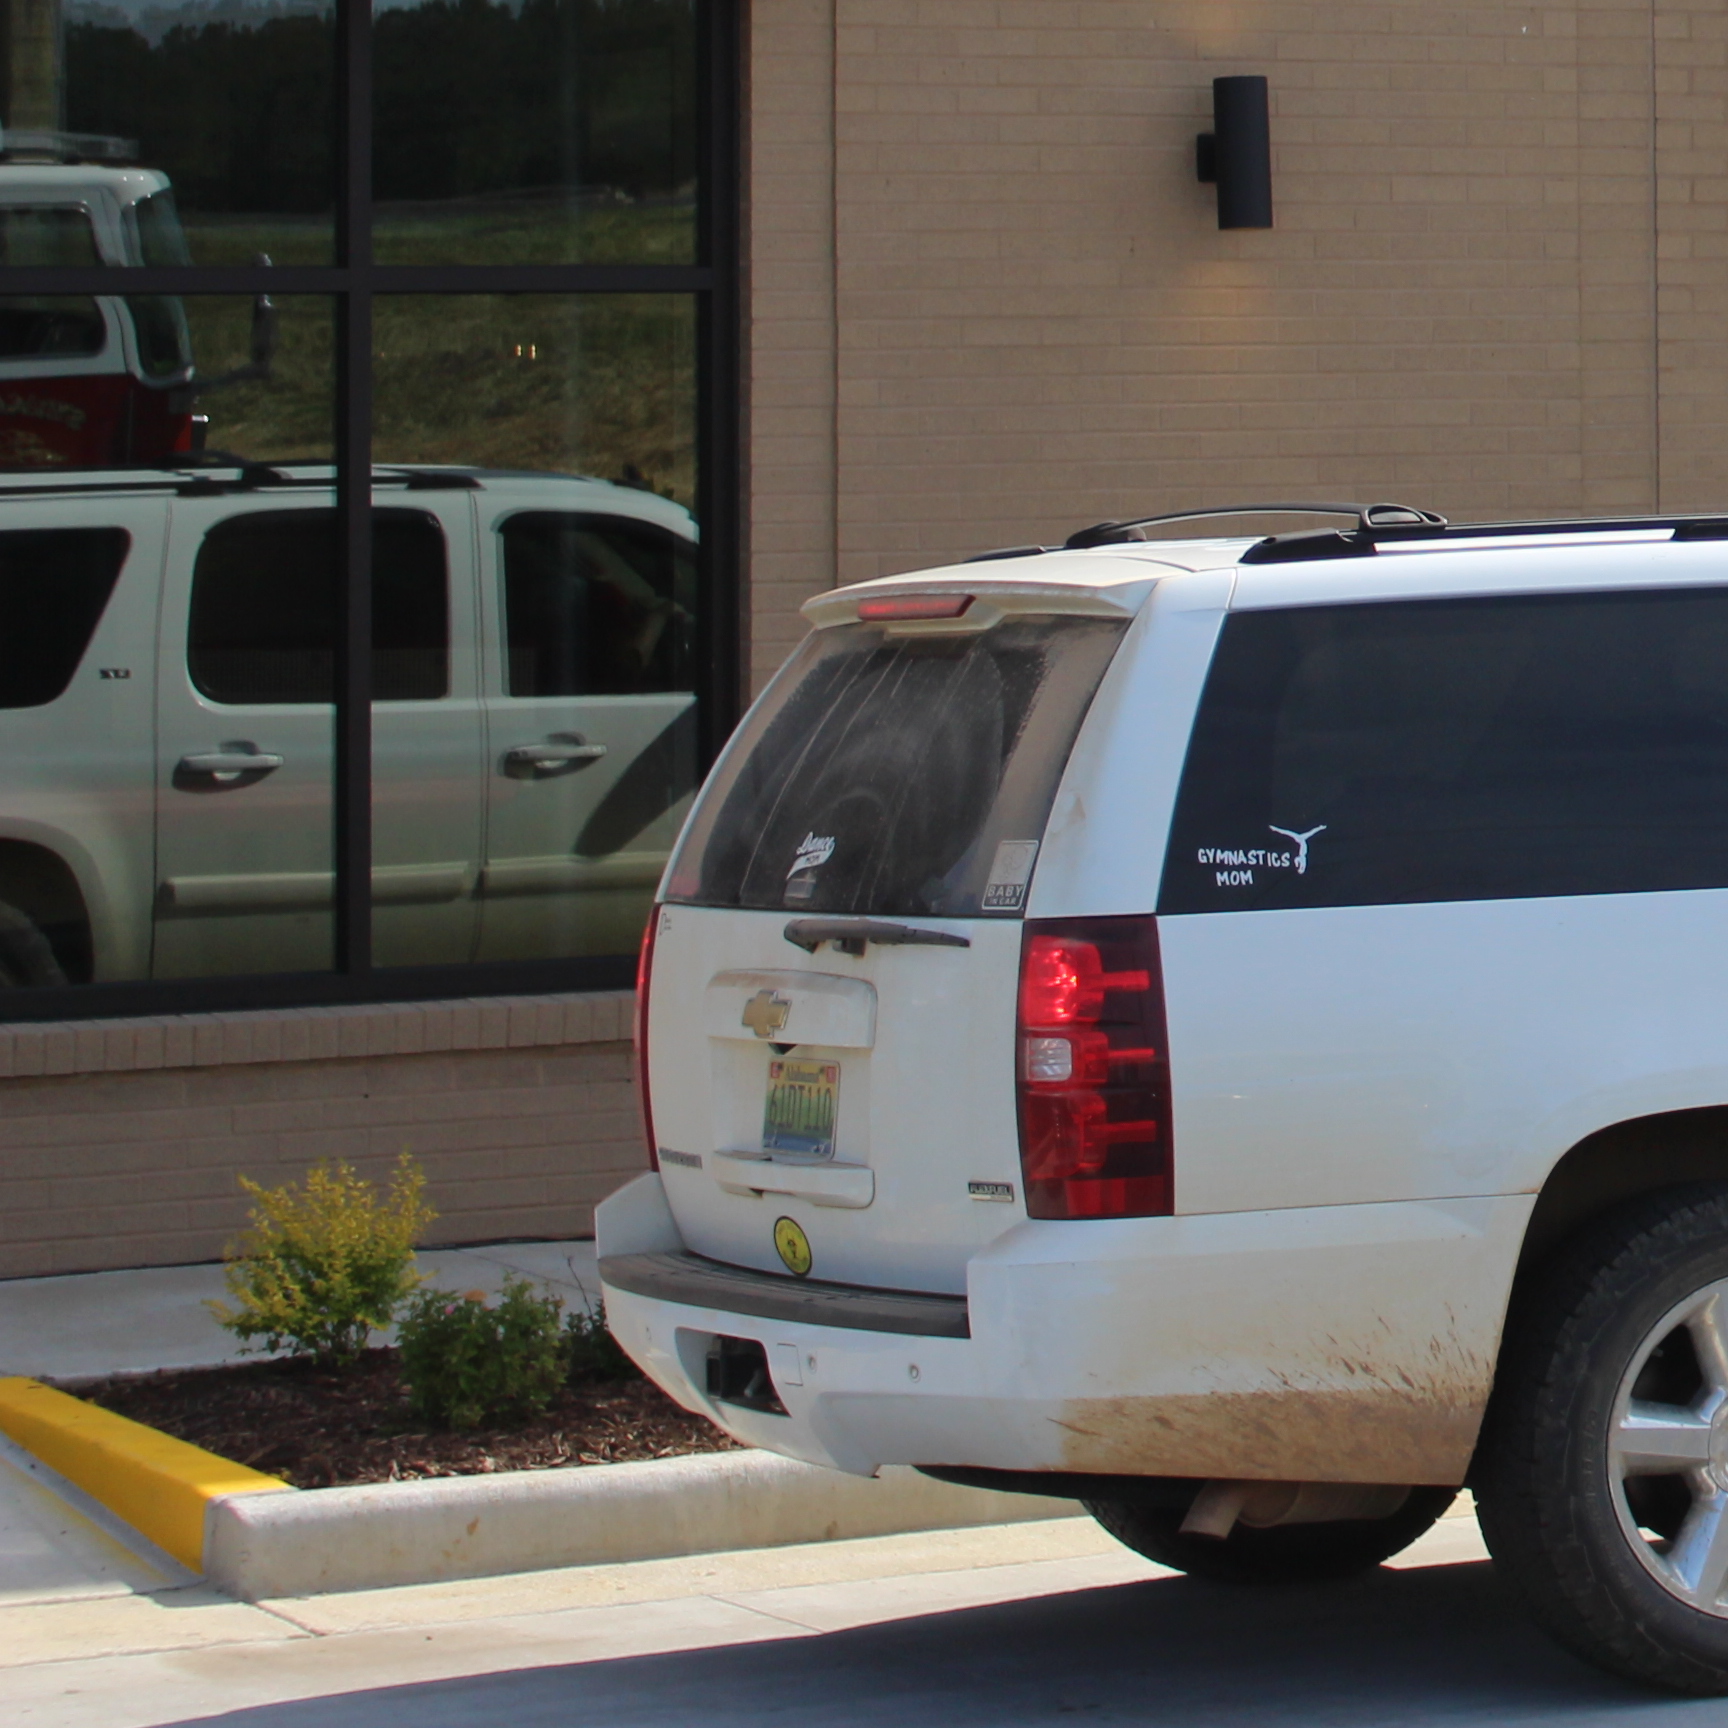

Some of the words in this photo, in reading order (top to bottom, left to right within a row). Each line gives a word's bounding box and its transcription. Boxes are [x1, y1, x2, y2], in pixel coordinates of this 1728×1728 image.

[1197, 848, 1291, 868] GYMNASTICS
[1215, 869, 1254, 887] MOM
[987, 885, 1024, 897] BABY
[999, 897, 1017, 906] CAR
[768, 1083, 833, 1132] 61DT110
